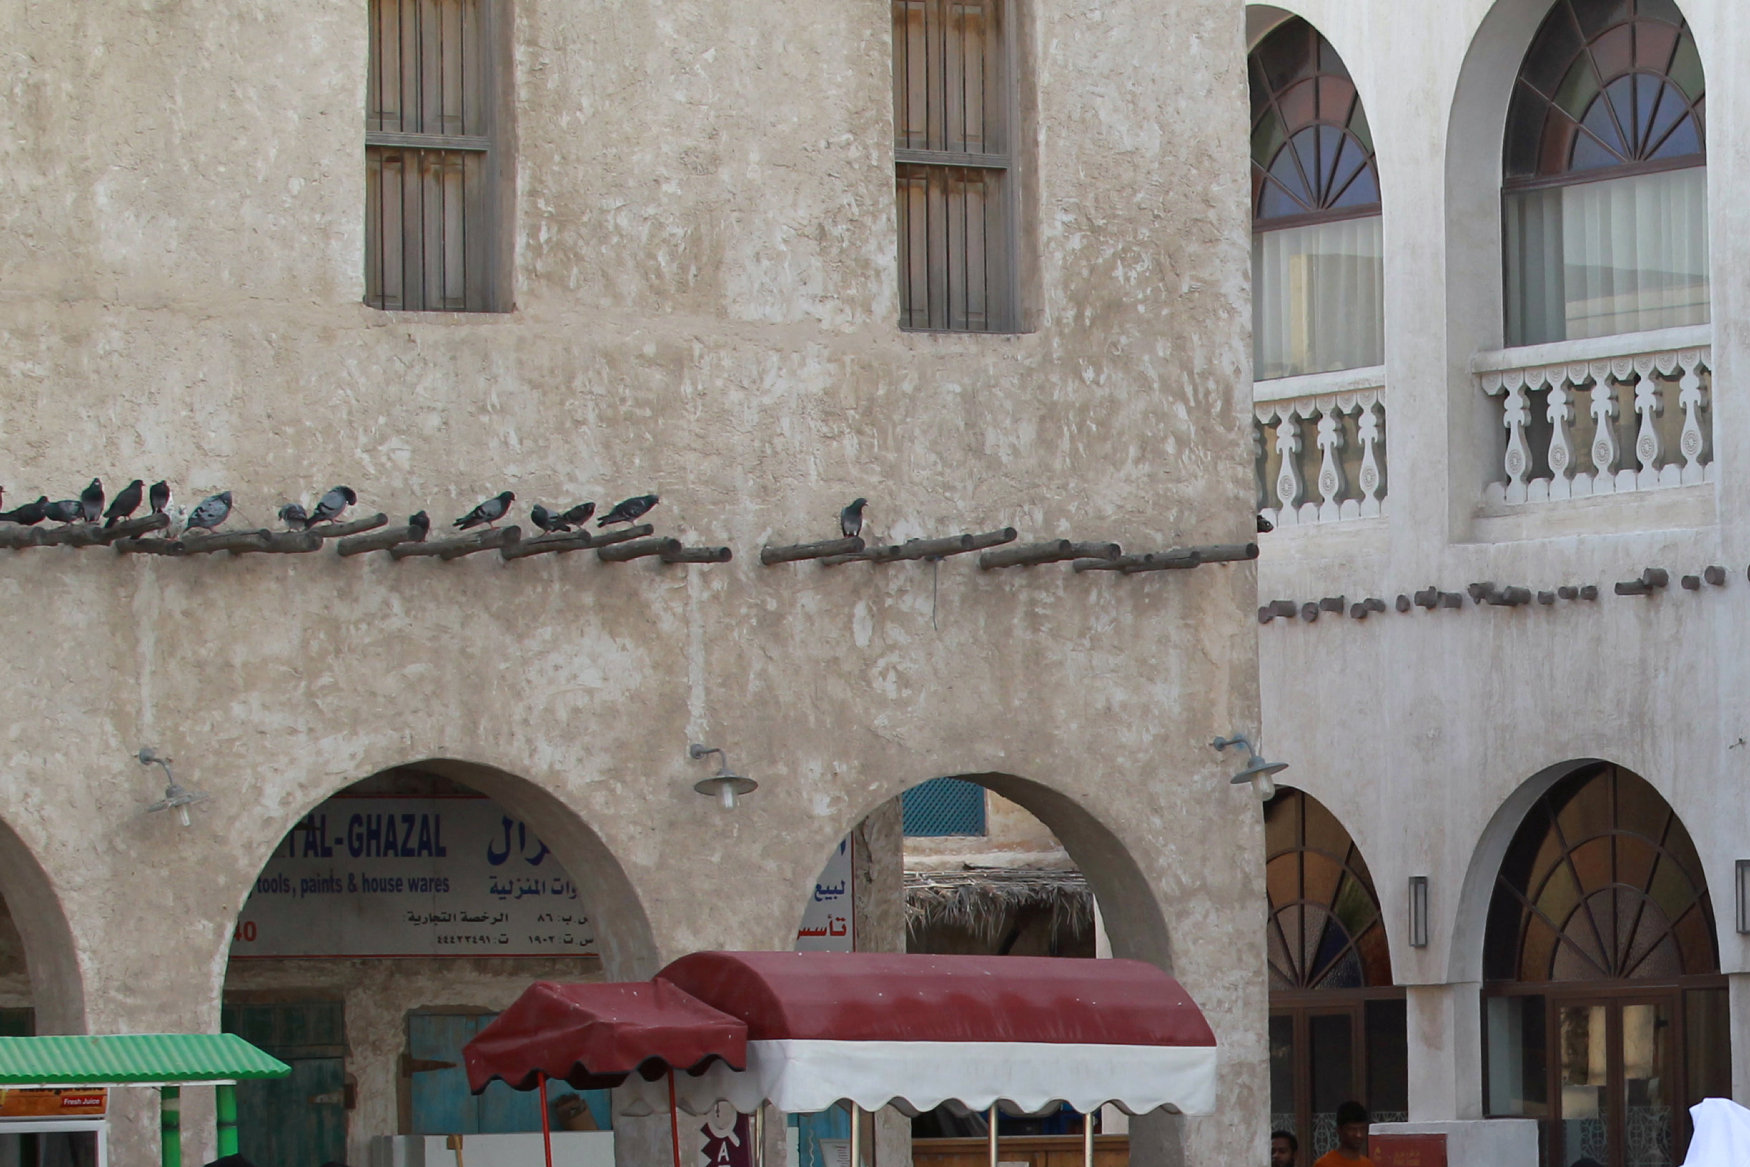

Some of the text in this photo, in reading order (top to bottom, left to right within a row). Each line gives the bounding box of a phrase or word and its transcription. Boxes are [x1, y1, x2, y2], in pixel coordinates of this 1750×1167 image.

[303, 813, 447, 859] AL-GHAZAL
[300, 871, 343, 898] paints
[347, 873, 358, 893] &
[362, 873, 403, 893] house
[408, 876, 450, 893] wares
[489, 875, 546, 900] المنزلية
[460, 910, 509, 925] الرخصة
[63, 1097, 100, 1105] Fresh Juice
